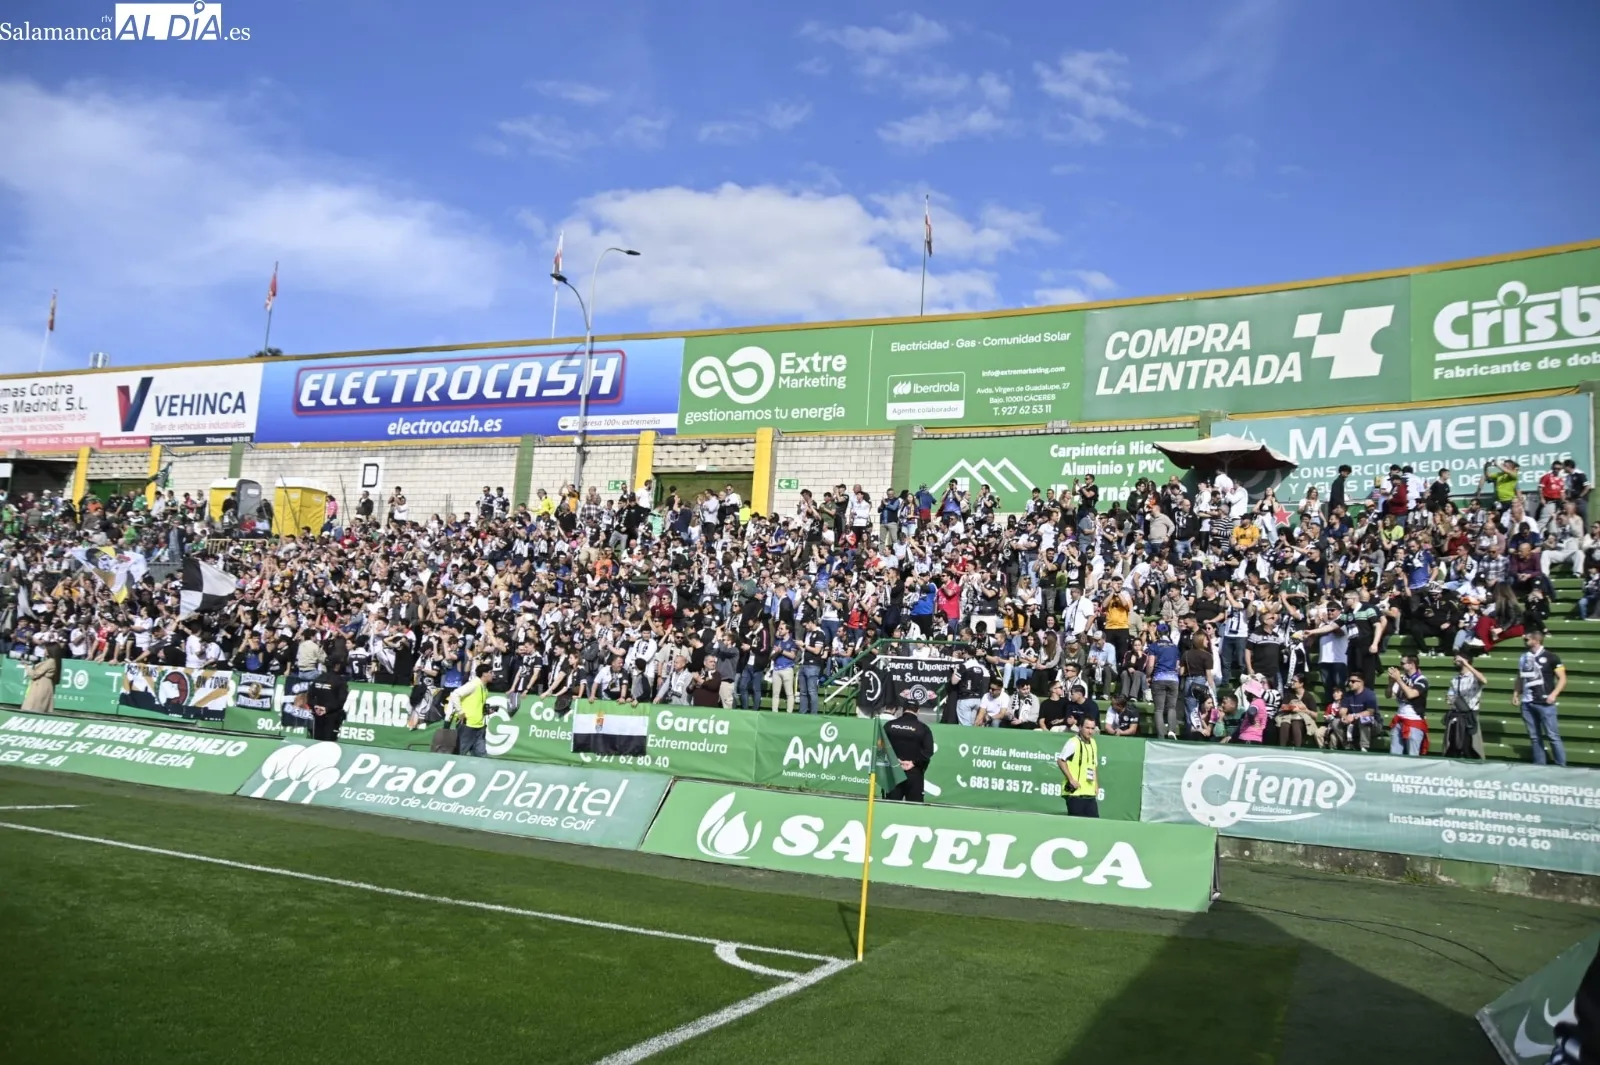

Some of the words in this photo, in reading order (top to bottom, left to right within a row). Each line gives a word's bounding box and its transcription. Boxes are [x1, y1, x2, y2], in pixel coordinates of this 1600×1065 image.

[890, 340, 950, 352] Electricidad
[955, 338, 976, 349] Gas
[982, 333, 1042, 347] Comunidad
[1043, 331, 1072, 342] Solar
[1105, 320, 1251, 362] COMPRA
[779, 351, 848, 375] Extre
[981, 366, 1066, 378] info@extremarketing.com
[1433, 359, 1532, 380] Fabricante
[1537, 356, 1561, 370] de
[299, 356, 620, 408] ELECTROCASH
[778, 373, 847, 391] Marketing
[1095, 351, 1302, 396] LAENTRADA
[30, 380, 74, 396] Contra
[913, 382, 960, 394] Iberdrola
[994, 386, 1015, 395] Virgen
[1015, 385, 1024, 393] de
[1061, 382, 1071, 390] 27
[65, 396, 88, 411] S.L.
[155, 391, 247, 418] VEHINCA
[1005, 395, 1023, 404] 10001
[684, 408, 772, 426] gestionamos
[773, 406, 788, 420] tu
[791, 403, 846, 422] energía
[892, 406, 916, 416] Agente
[917, 405, 959, 415] colaborador
[993, 407, 1000, 416] T.
[1001, 406, 1018, 416] 927
[1018, 405, 1031, 415] 62
[1031, 405, 1044, 414] 53
[1045, 404, 1052, 414] 11
[387, 416, 503, 436] electrocash.es
[1289, 408, 1573, 462] MÁSMEDIO
[1050, 440, 1126, 460] Carpintería
[362, 463, 380, 488] D
[1061, 460, 1124, 476] Aluminio
[1127, 462, 1135, 477] y
[1138, 459, 1165, 474] PVC
[1290, 463, 1392, 479] CONSRCIO
[1288, 483, 1300, 495] Y
[656, 710, 730, 736] García
[0, 716, 81, 737] MANUEL
[75, 723, 153, 745] FERRER
[148, 732, 248, 757] BERMEJO
[528, 724, 573, 742] Paneles
[647, 734, 728, 755] Extremadura
[21, 753, 50, 765] 42
[45, 755, 69, 767] 41
[64, 741, 94, 754] DE
[88, 743, 196, 769] ALBAÑILERÍA
[636, 754, 652, 767] 80
[654, 755, 670, 768] 40
[971, 745, 981, 756] C/
[982, 746, 1007, 758] Eladia
[971, 758, 997, 769] 10001
[1001, 759, 1032, 772] Cáceres
[339, 753, 476, 800] Prado
[477, 769, 629, 818] Plantel
[782, 769, 817, 780] Animación
[820, 773, 837, 782] Ocio
[1364, 772, 1465, 788] CLIMATIZACIÓN
[1473, 780, 1503, 790] GAS
[969, 775, 989, 790] 683
[991, 777, 1005, 792] 58
[1005, 779, 1020, 793] 35
[1021, 780, 1034, 794] 72
[1040, 782, 1062, 797] 689
[1391, 783, 1496, 801] INSTALACIONES
[1498, 791, 1600, 809] INDUSTRIALES
[339, 787, 358, 798] Tu
[355, 791, 400, 806] centro
[401, 795, 422, 809] de
[421, 797, 490, 819] Jardinería
[492, 809, 513, 822] en
[515, 810, 558, 828] Ceres
[560, 816, 597, 832] Golf
[1252, 804, 1293, 815] instalaciones
[1444, 806, 1541, 824] www.iteme.es
[1458, 831, 1483, 844] 927
[1486, 833, 1504, 846] 87
[1507, 835, 1528, 849] 04
[1531, 838, 1552, 851] 60
[772, 814, 1153, 889] SATELCA
